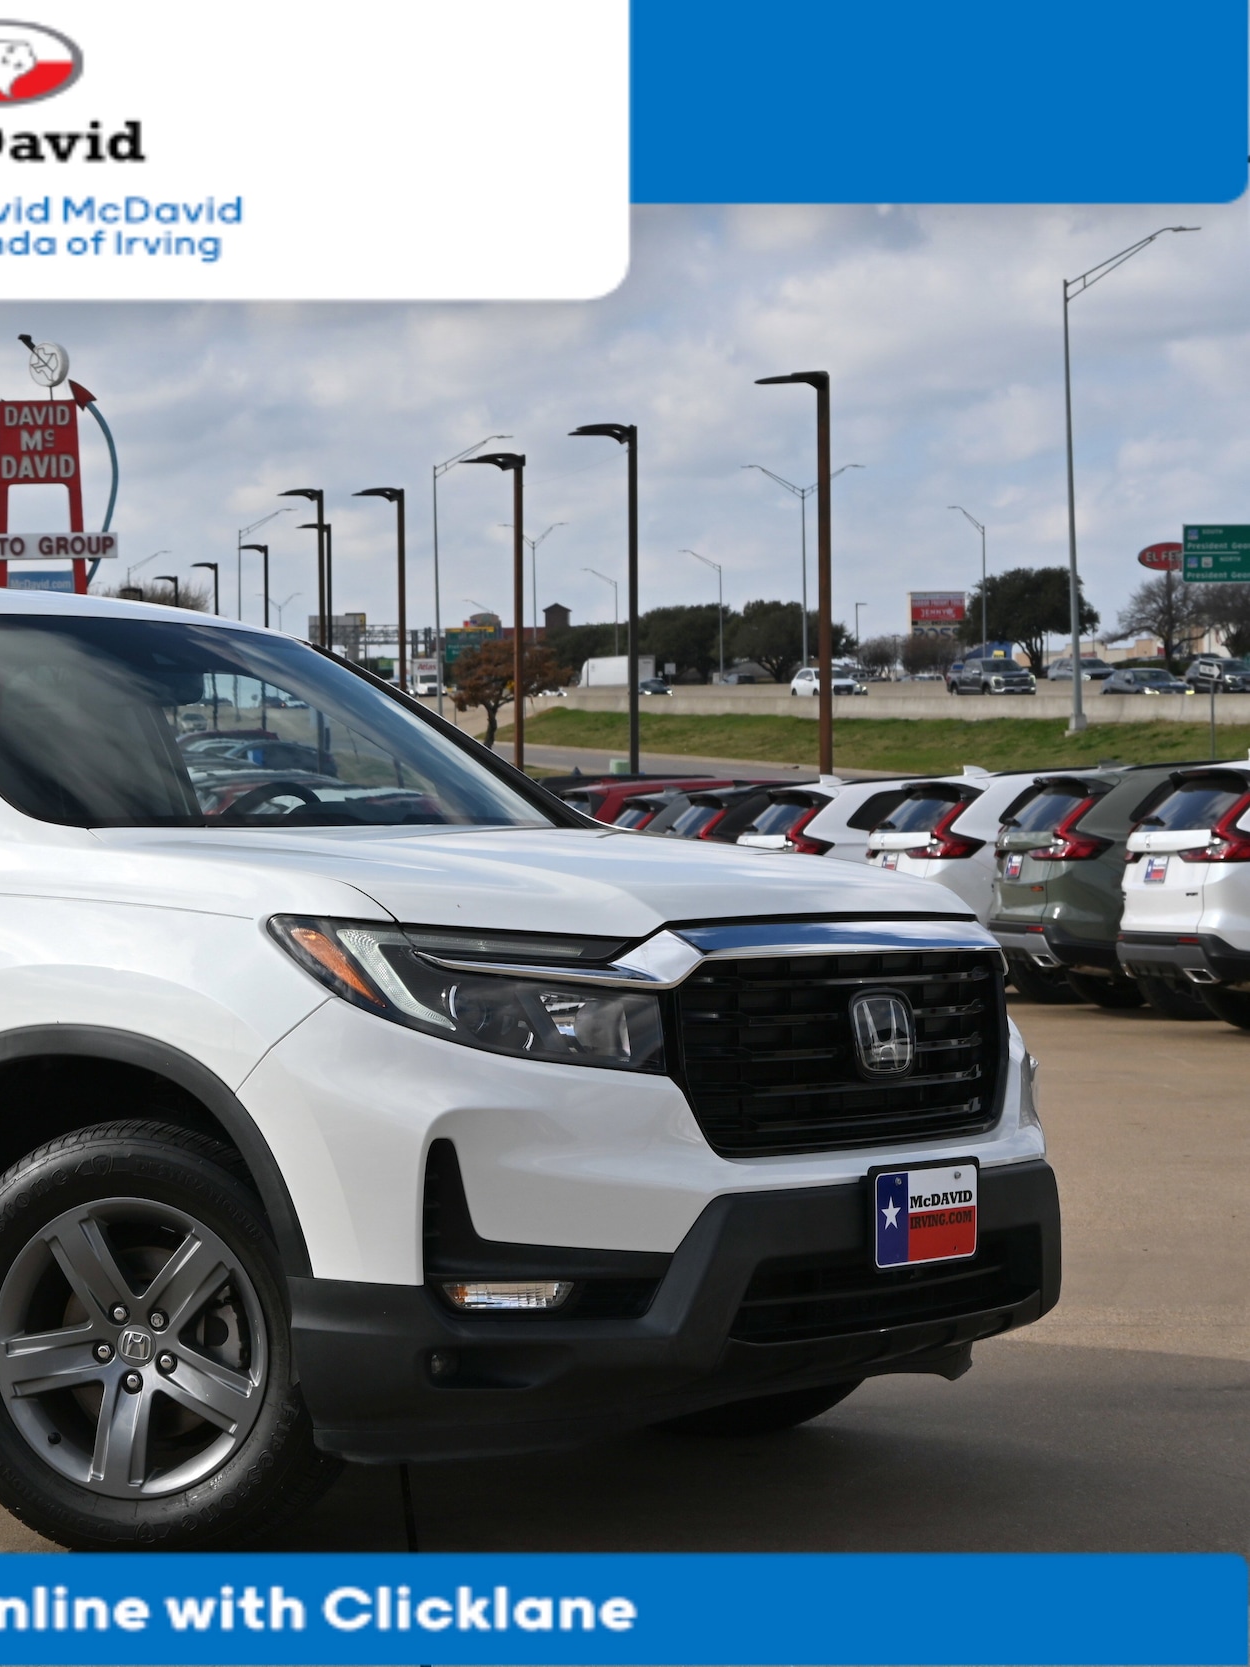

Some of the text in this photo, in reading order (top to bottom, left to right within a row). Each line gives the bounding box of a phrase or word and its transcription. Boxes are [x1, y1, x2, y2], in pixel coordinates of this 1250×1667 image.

[4, 405, 71, 427] DAVID
[0, 454, 76, 480] DAVID
[38, 532, 115, 556] GROUP
[909, 1189, 973, 1209] McDAVID
[909, 1210, 973, 1230] IRVING.COM
